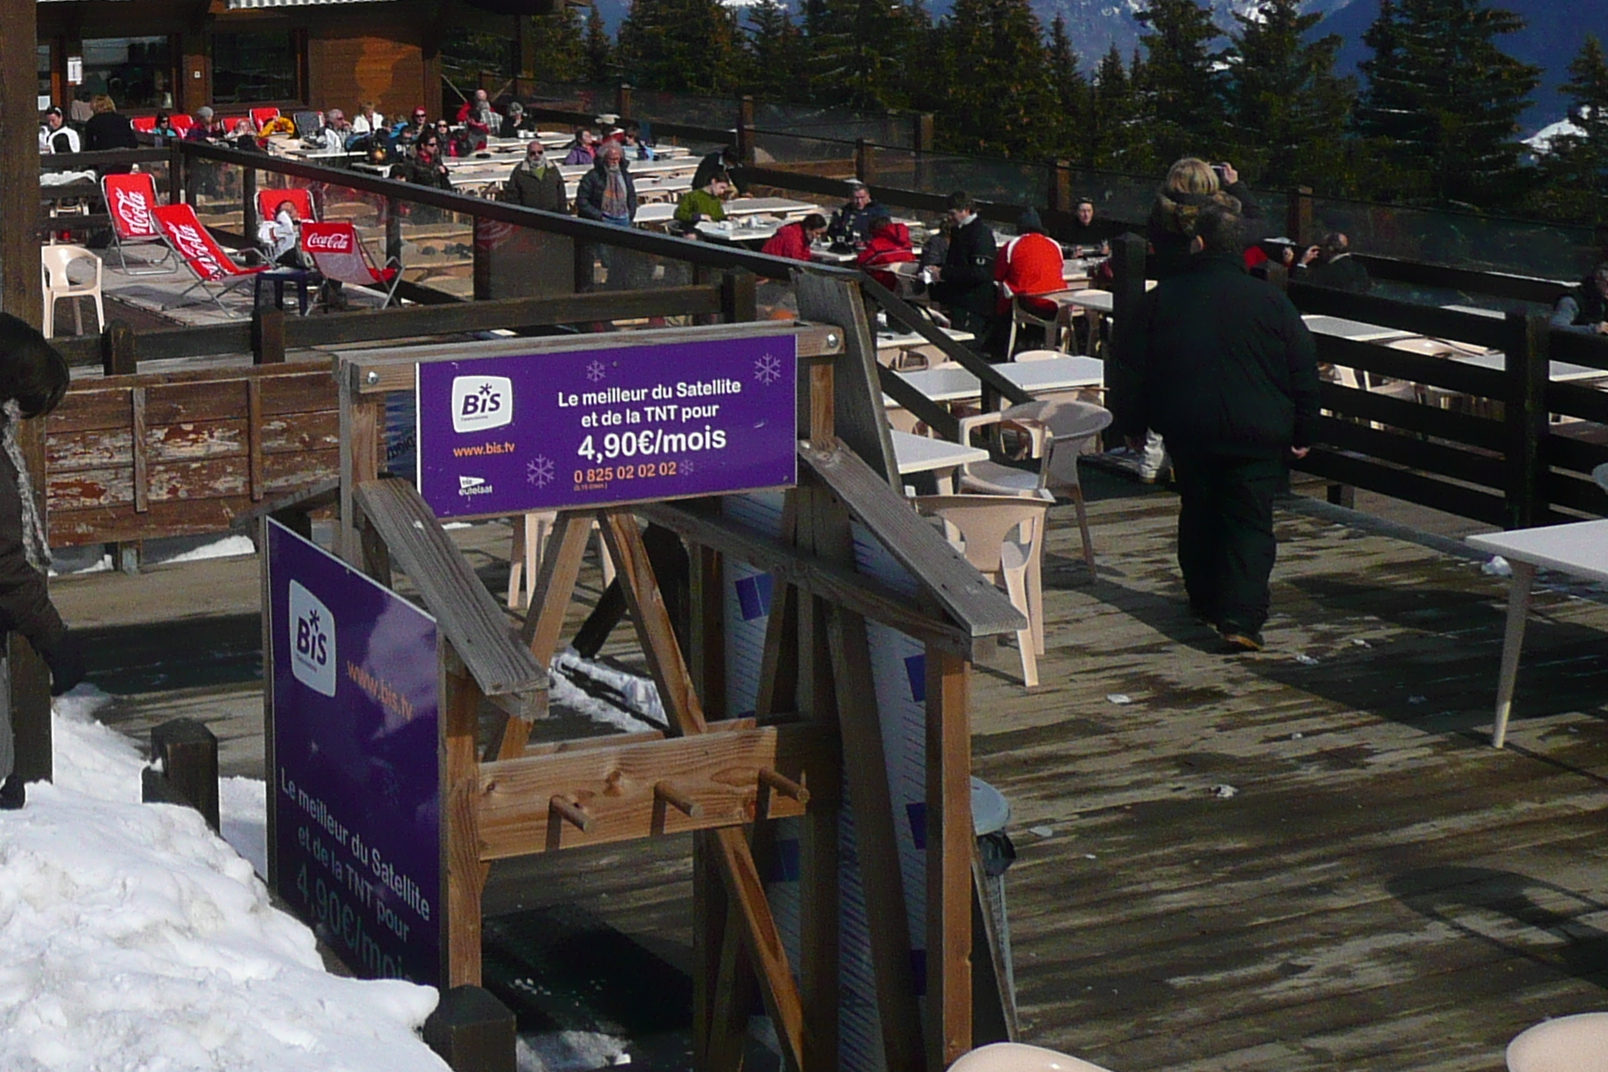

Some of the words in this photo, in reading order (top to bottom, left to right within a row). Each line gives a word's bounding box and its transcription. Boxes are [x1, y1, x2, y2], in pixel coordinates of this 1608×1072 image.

[558, 391, 579, 408] Le
[582, 387, 648, 406] meilleur
[652, 383, 673, 400] du
[676, 379, 742, 398] Satellite
[581, 412, 598, 427] et
[601, 410, 622, 426] de
[625, 408, 641, 424] la
[644, 406, 678, 423] TNT
[681, 404, 720, 423] pour
[453, 442, 515, 458] www.bis.tv
[577, 425, 727, 463] 4,90€/mois
[574, 470, 583, 483] 0
[587, 467, 613, 482] 825
[617, 465, 634, 479] 02
[638, 463, 656, 478] 02
[659, 461, 677, 476] 02
[347, 660, 413, 722] www.bis.tv
[281, 767, 296, 800] Le
[298, 797, 349, 847] meilleur
[351, 833, 368, 865] du
[372, 848, 430, 921] Satellite
[298, 826, 311, 853] et
[313, 837, 329, 868] de
[331, 850, 342, 880] la
[345, 863, 373, 909] TNT
[377, 898, 410, 942] pour
[297, 863, 410, 979] 4,90€/moi
